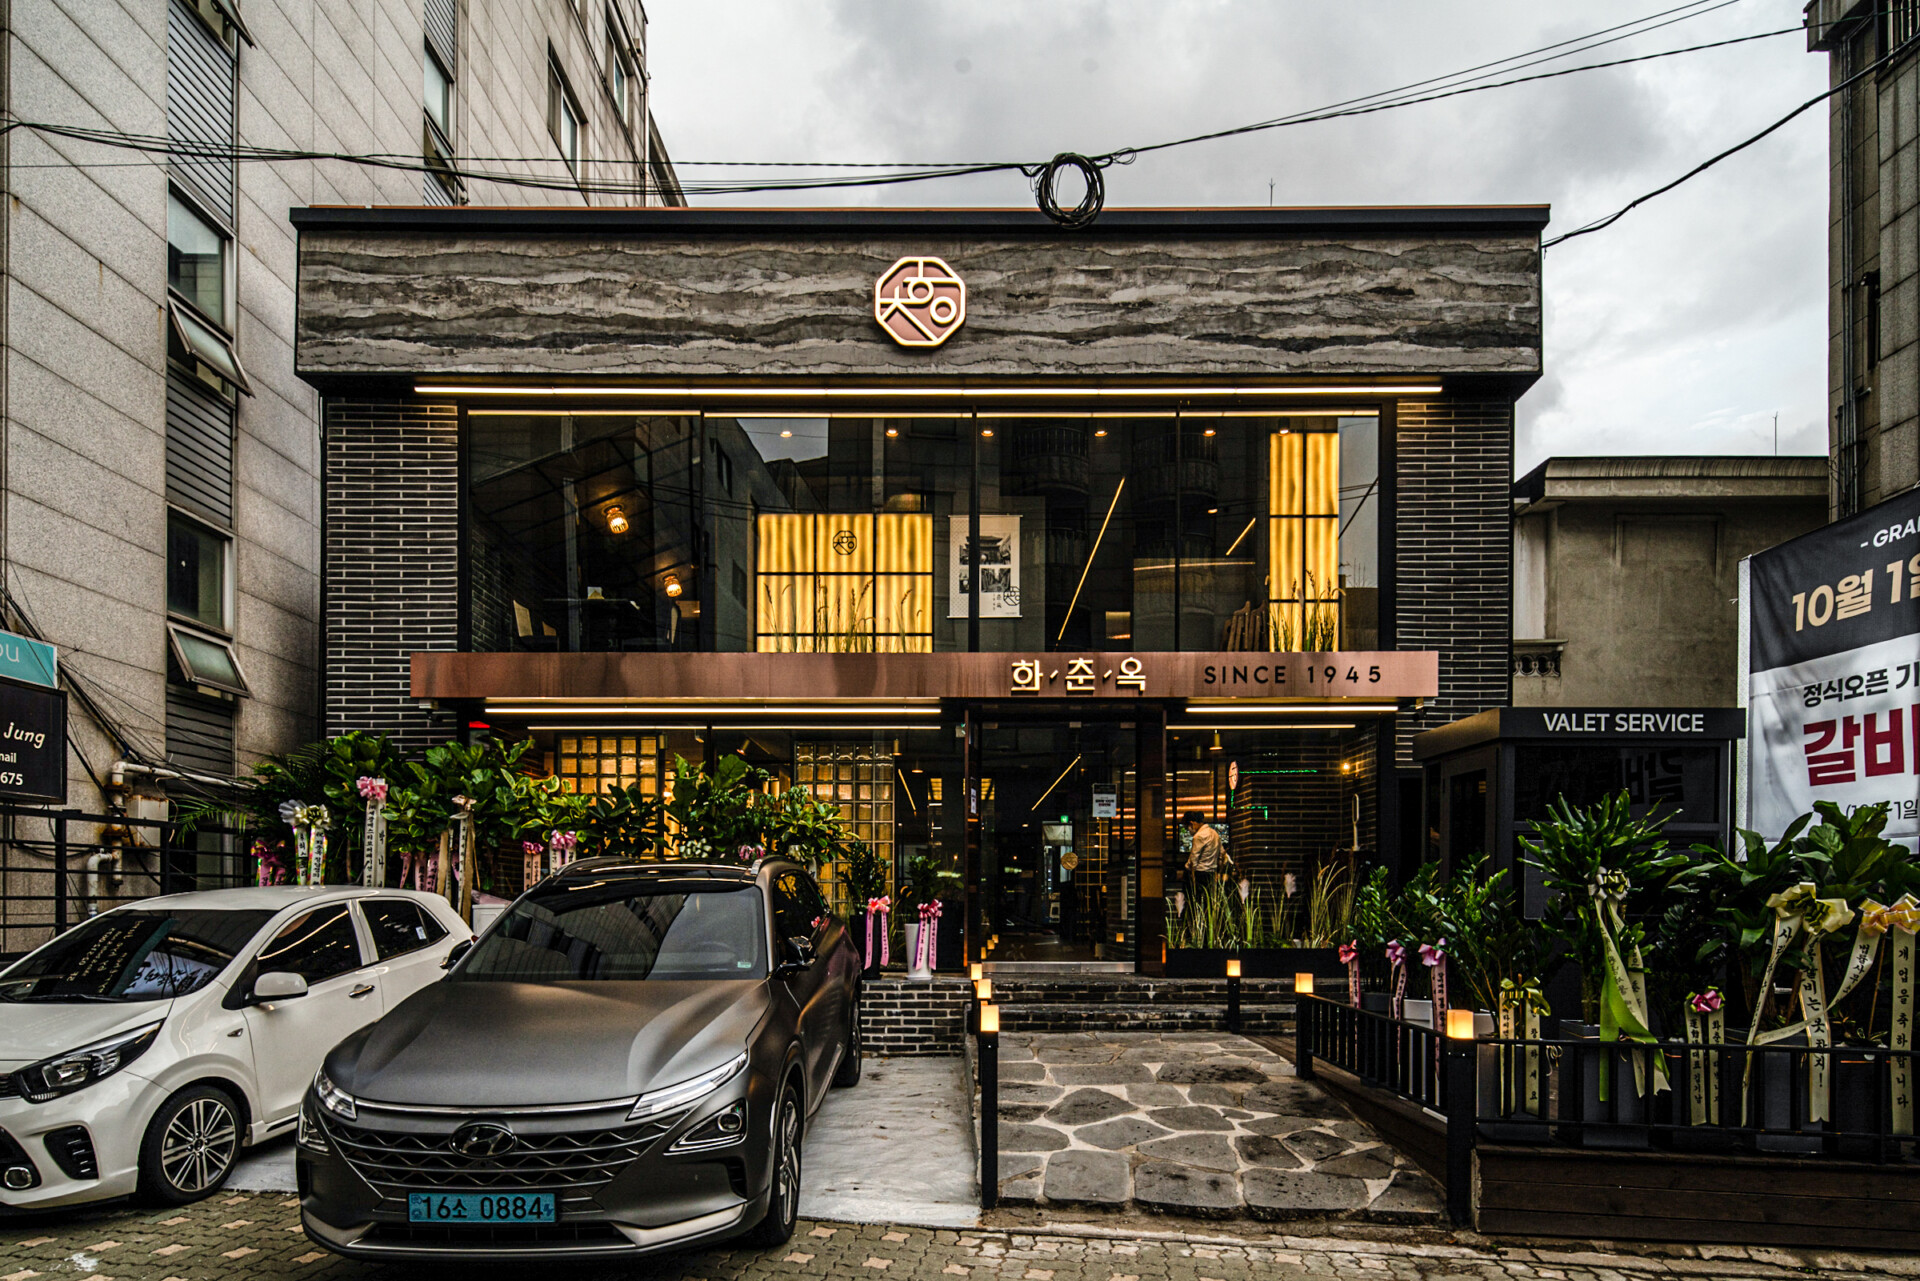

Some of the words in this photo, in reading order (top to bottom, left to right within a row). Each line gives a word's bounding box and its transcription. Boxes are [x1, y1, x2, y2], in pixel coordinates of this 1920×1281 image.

[1872, 514, 1920, 548] GRA
[1792, 567, 1874, 632] 10월
[0, 643, 20, 663] u
[1203, 664, 1287, 685] SINCE
[1307, 664, 1383, 685] 1945
[1803, 667, 1890, 708] 정식오픈
[3, 721, 46, 750] jung
[1542, 712, 1610, 732] VALET
[1615, 713, 1705, 733] SERVICE
[422, 1196, 468, 1219] 16소
[480, 1196, 544, 1220] 0884
